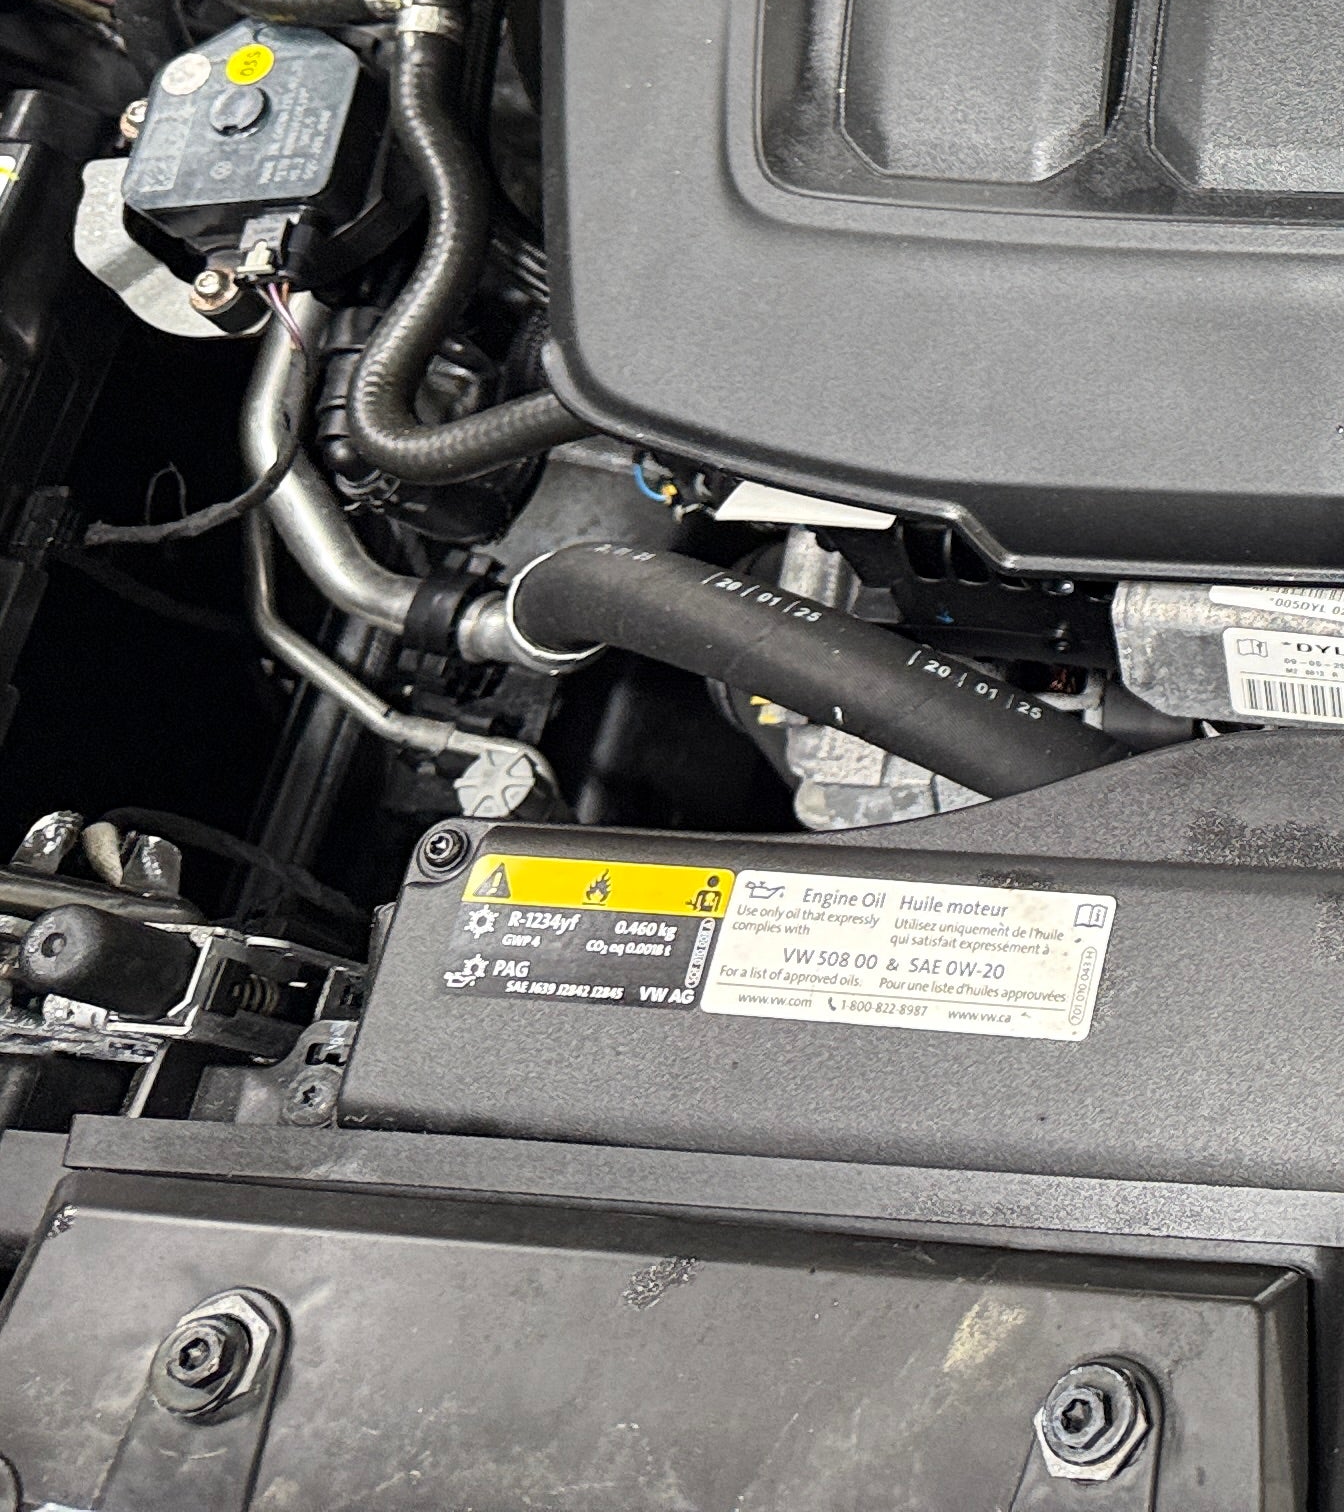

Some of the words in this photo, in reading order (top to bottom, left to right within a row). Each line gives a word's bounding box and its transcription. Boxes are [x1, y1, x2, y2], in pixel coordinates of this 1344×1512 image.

[715, 578, 742, 591] 20
[757, 593, 782, 606] 01
[794, 608, 822, 621] 25
[924, 660, 951, 678] 20
[976, 683, 998, 700] 01
[803, 888, 858, 909] Engine
[862, 892, 886, 908] Oil
[900, 895, 943, 912] Huile
[947, 901, 1009, 917] moteur
[508, 911, 581, 935] R-1234yf
[737, 904, 757, 917] Use
[760, 905, 784, 921] only
[786, 909, 800, 919] oil
[802, 910, 825, 921] that
[827, 914, 880, 928] expressly
[502, 934, 530, 946] GWP
[531, 935, 541, 947] 4
[615, 920, 656, 936] 0.460
[657, 922, 677, 941] kg
[733, 920, 781, 939] complies
[785, 923, 810, 935] with
[894, 918, 937, 931] Utilisez
[939, 923, 1009, 939] uniquement
[1012, 926, 1026, 938] de
[1029, 927, 1064, 941] l'huile
[890, 934, 909, 947] qui
[912, 935, 956, 949] satisfait
[959, 940, 1040, 955] expressément
[1042, 943, 1050, 955] à
[493, 959, 530, 977] PAG
[784, 947, 815, 964] VW
[817, 951, 850, 967] 508
[854, 954, 878, 970] 00
[886, 958, 899, 971] &
[908, 957, 943, 975] SAE
[946, 961, 1005, 980] 0W-20
[505, 980, 529, 994] SAE
[720, 965, 737, 977] For
[740, 969, 747, 977] a
[750, 967, 766, 980] list
[769, 968, 782, 980] of
[783, 972, 837, 985] approved
[840, 976, 862, 987] oils.
[639, 986, 669, 1002] VW
[668, 989, 695, 1004] AG
[879, 977, 905, 990] Pour
[907, 982, 929, 992] une
[932, 981, 954, 994] liste
[956, 982, 999, 998] d'huiles
[1001, 988, 1066, 1002] approuvées
[738, 993, 812, 1008] www.vw.com
[841, 998, 928, 1017] 1-800-822-8987
[948, 1009, 1012, 1023] www.vw.ca
